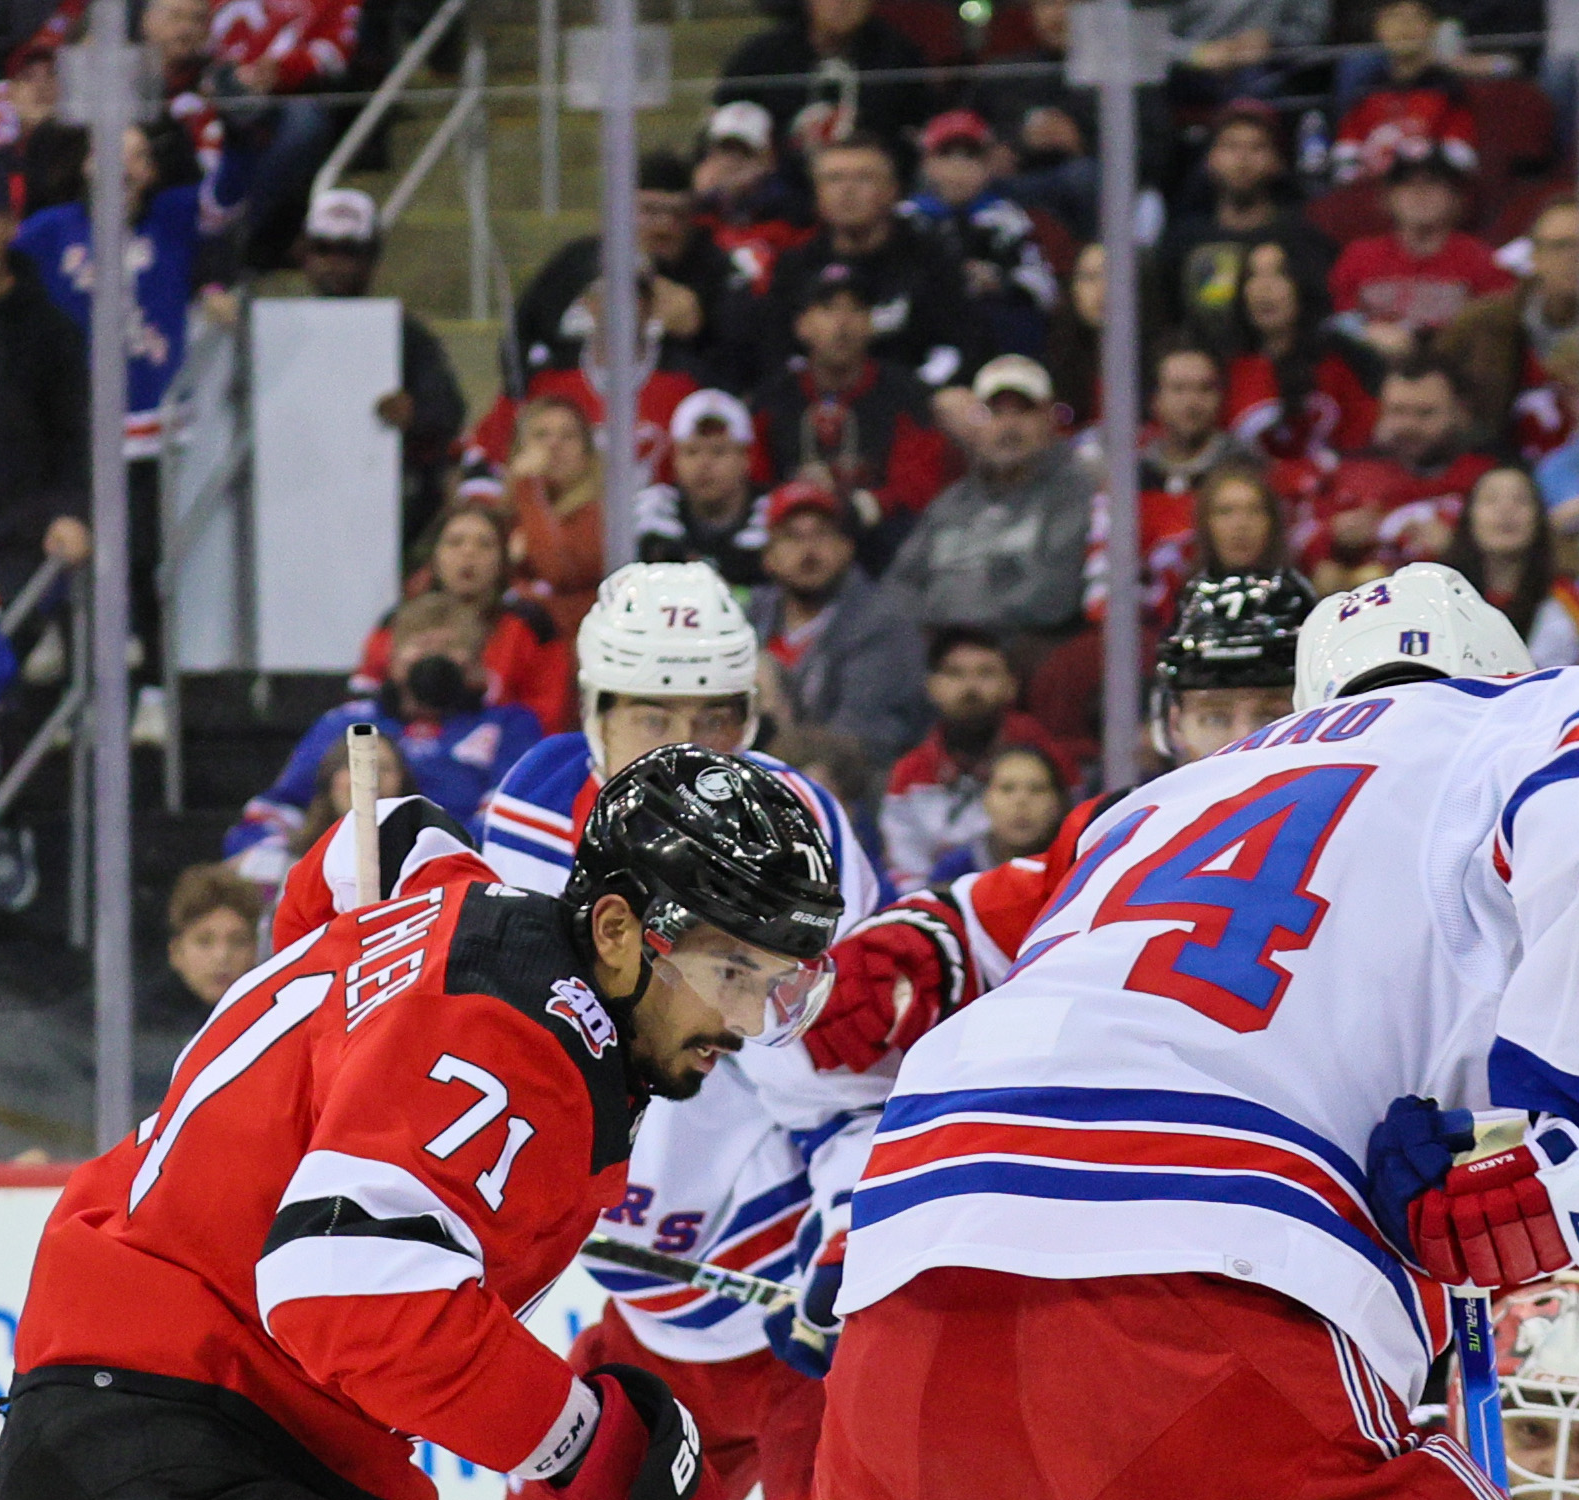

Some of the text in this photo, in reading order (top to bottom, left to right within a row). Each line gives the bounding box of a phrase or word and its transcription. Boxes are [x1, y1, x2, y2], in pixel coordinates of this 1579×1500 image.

[660, 605, 700, 628] 72
[423, 1053, 536, 1213] 71
[534, 1411, 586, 1473] CCM
